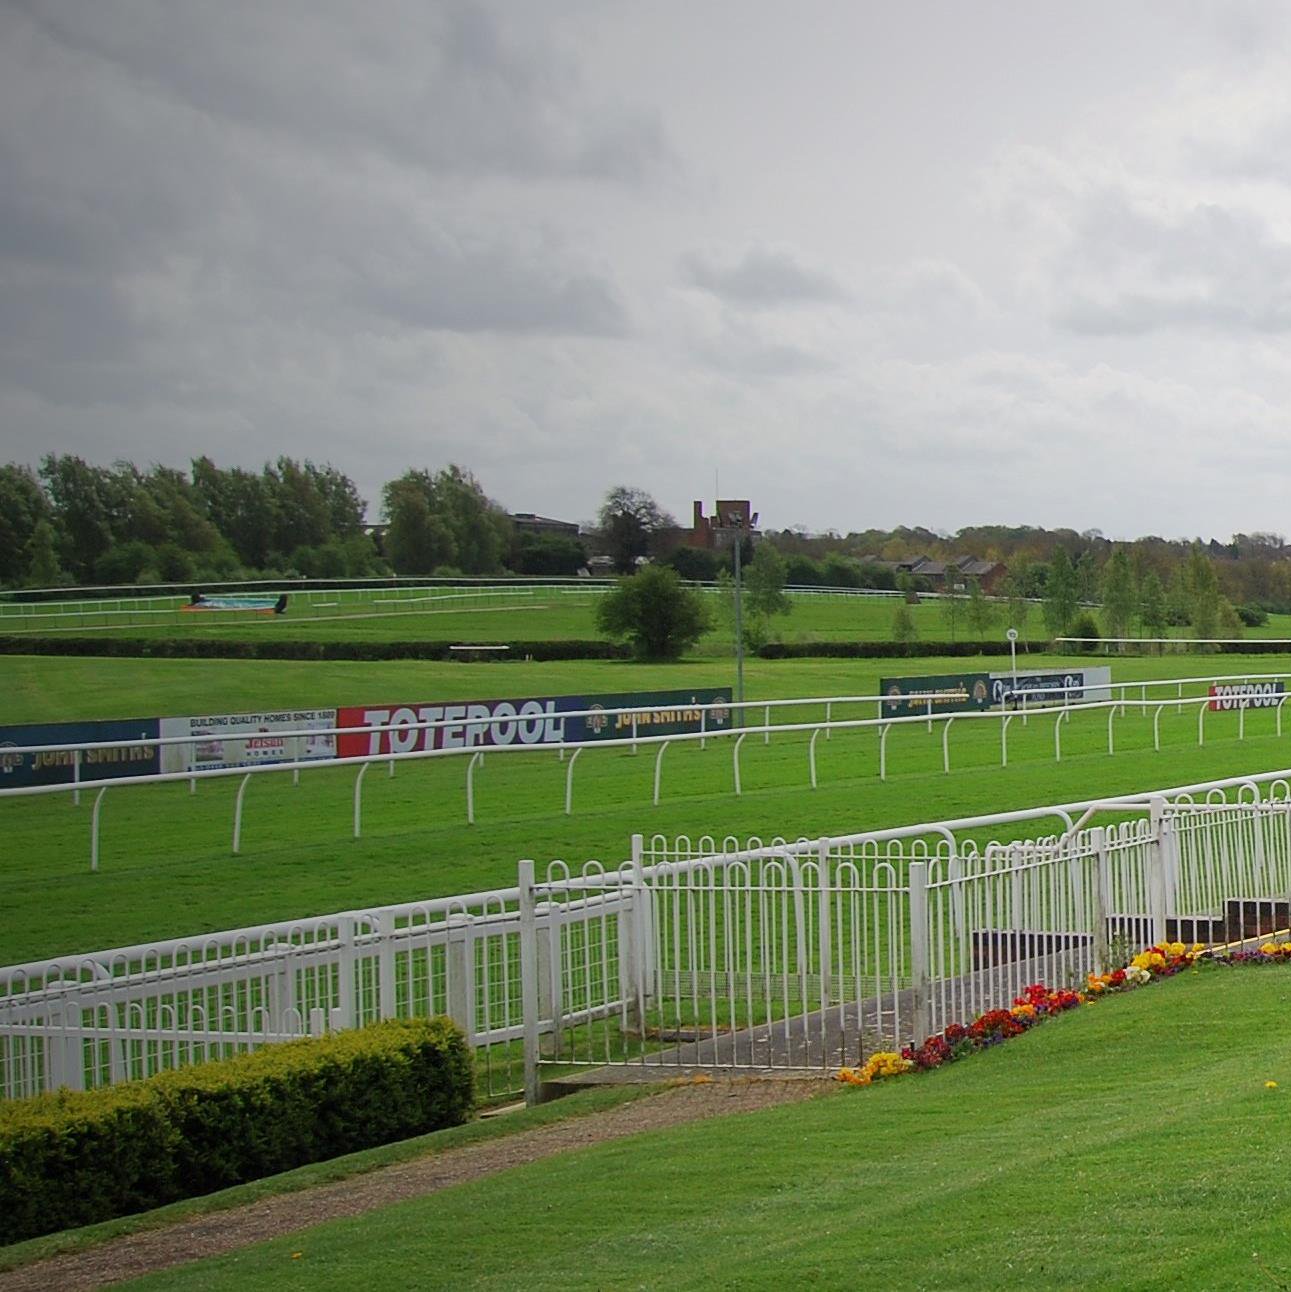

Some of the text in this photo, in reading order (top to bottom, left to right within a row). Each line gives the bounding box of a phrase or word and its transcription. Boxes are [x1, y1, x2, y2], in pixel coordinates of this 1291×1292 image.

[1215, 683, 1280, 709] TOTEPOOL
[190, 716, 229, 728] BUILDING
[230, 714, 262, 725] QUALITY
[264, 713, 292, 723] HOMES
[293, 711, 315, 722] SINCE
[363, 700, 562, 755] TOTEPOOL
